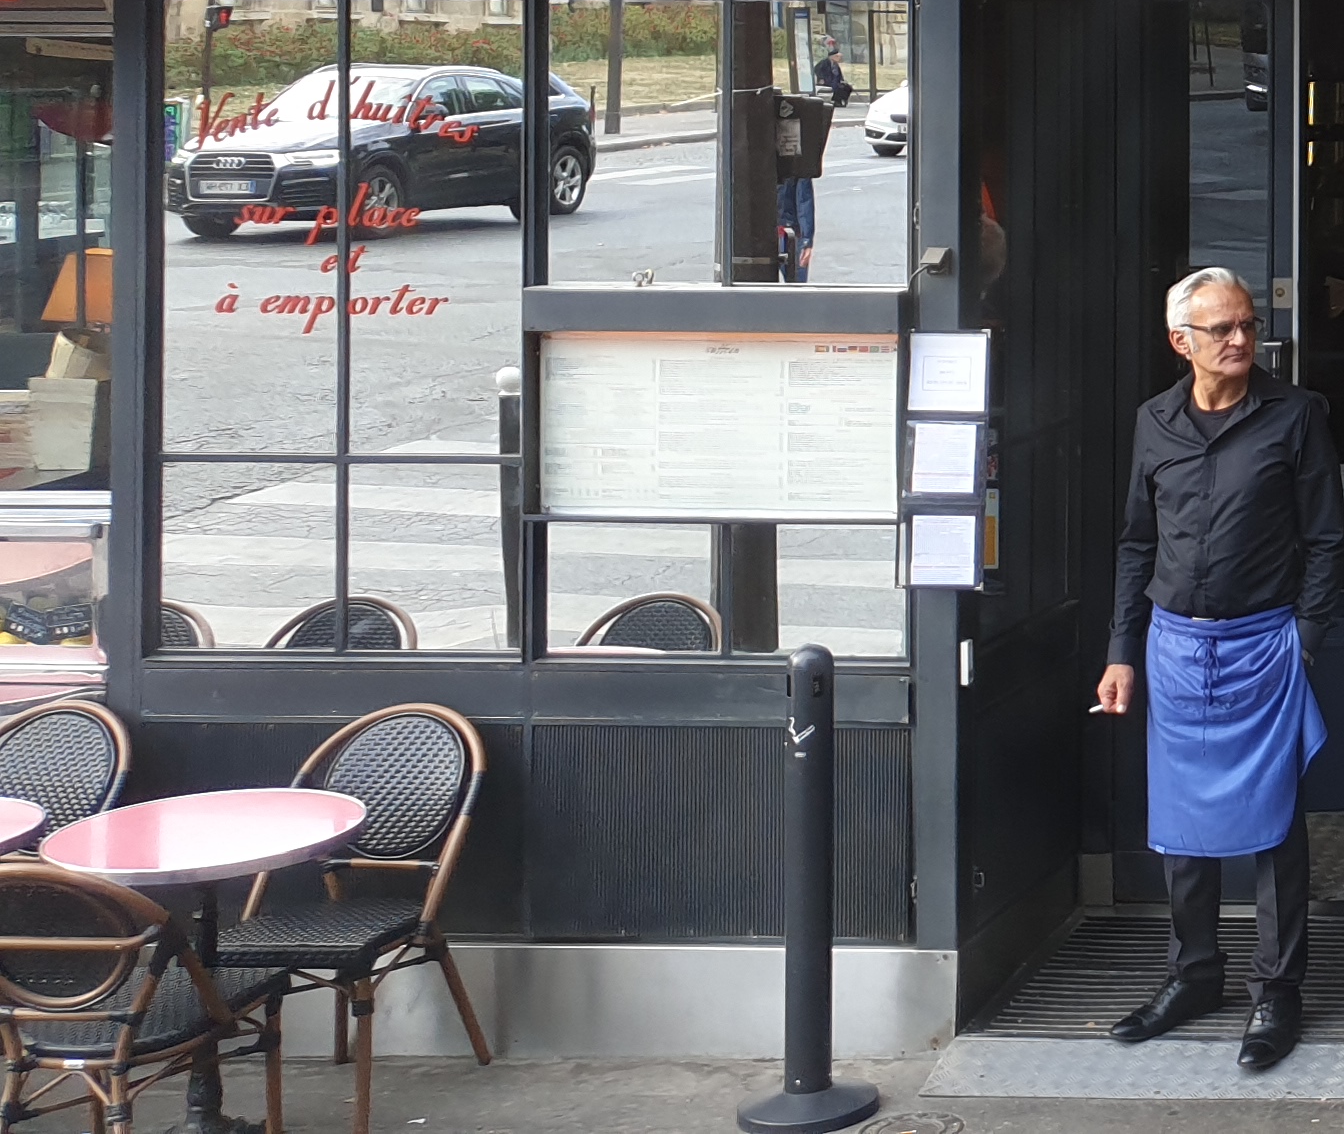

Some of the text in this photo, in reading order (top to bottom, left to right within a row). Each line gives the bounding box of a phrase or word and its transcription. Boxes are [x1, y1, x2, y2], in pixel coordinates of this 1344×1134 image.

[197, 92, 279, 149] Vente
[234, 182, 421, 246] sur place
[320, 245, 367, 274] et
[215, 282, 451, 335] à emporter
